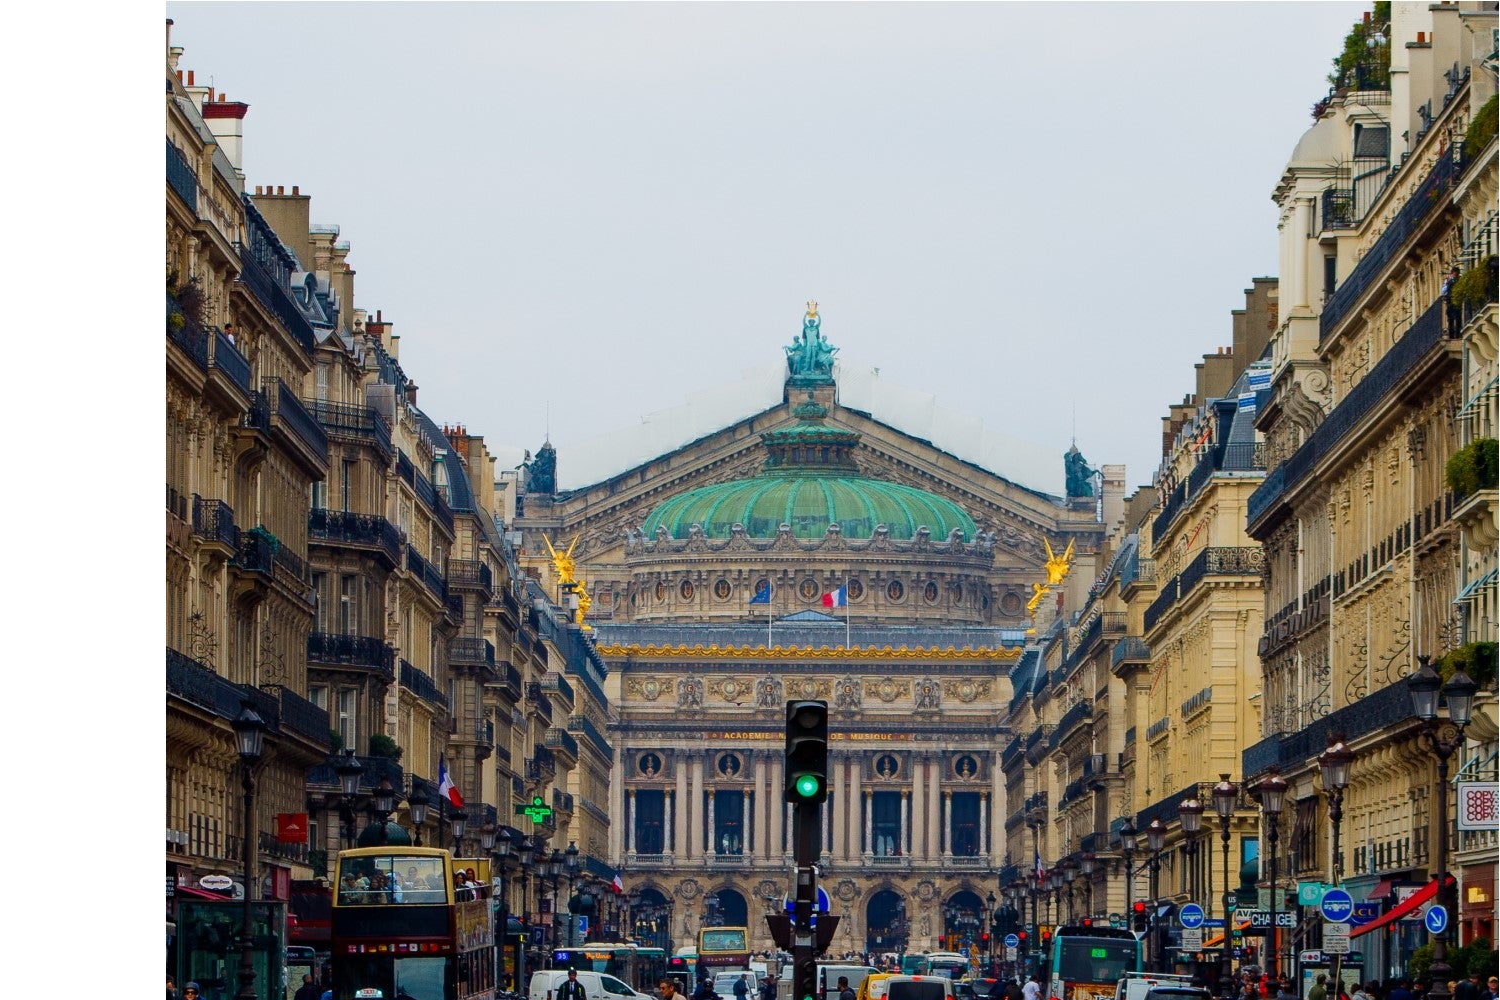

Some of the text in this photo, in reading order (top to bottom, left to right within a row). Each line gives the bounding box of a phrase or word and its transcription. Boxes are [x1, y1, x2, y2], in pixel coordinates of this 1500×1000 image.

[1467, 791, 1495, 799] COPY
[1467, 798, 1495, 806] COPY
[1467, 805, 1495, 814] COPY
[1467, 812, 1495, 821] COPY
